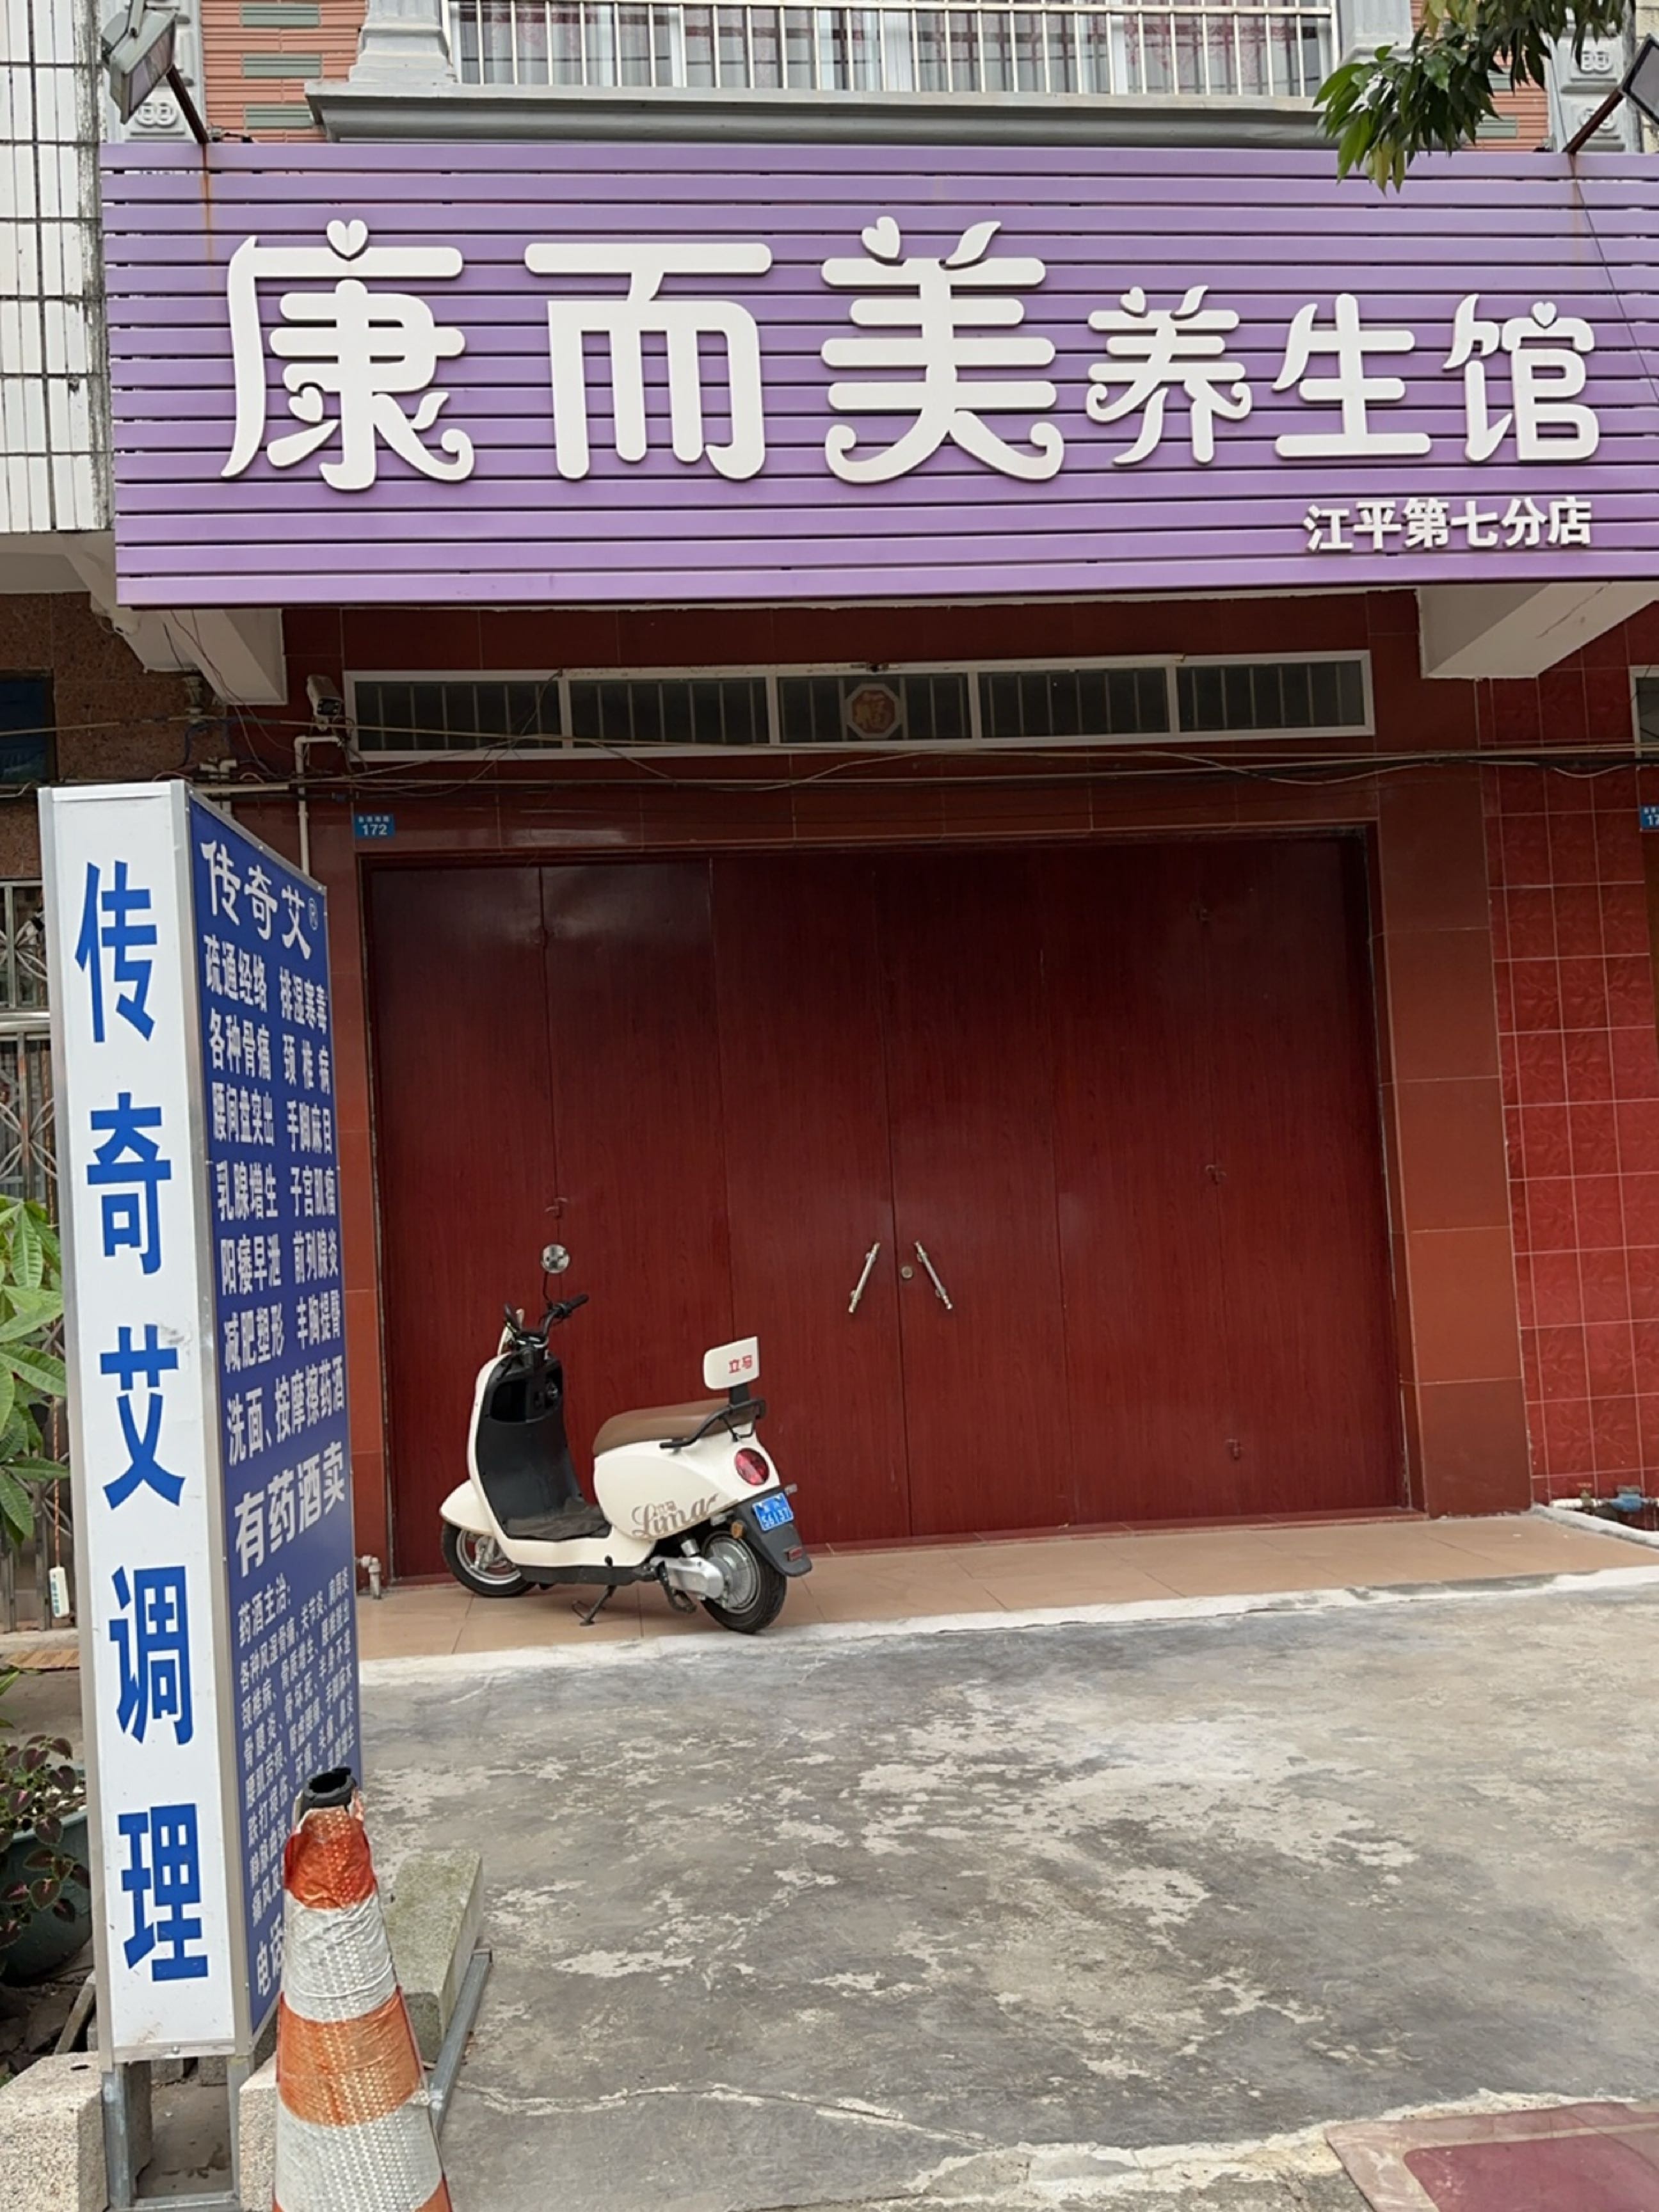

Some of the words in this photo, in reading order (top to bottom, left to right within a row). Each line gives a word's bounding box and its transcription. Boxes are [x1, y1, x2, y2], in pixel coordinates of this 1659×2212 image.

[214, 217, 1598, 490] 康而美养生馆
[1304, 496, 1592, 550] 江平第七分店
[362, 824, 388, 836] 172
[202, 841, 312, 959] 传奇艾
[204, 935, 266, 1011] 疏通经络
[210, 1008, 271, 1080] 各种骨痛
[212, 1082, 273, 1145] 腰间盘突出
[216, 1161, 278, 1221] 乳腺增生
[291, 1166, 335, 1216] 子宫肌瘤
[221, 1234, 281, 1295] 阳痿早泄
[294, 1230, 338, 1283] 前列腺炎
[225, 1303, 284, 1372] 减肥塑形
[297, 1290, 340, 1349] 丰胸提臀
[76, 862, 208, 1981] 传奇艾调理
[235, 1441, 346, 1577] 有药酒卖
